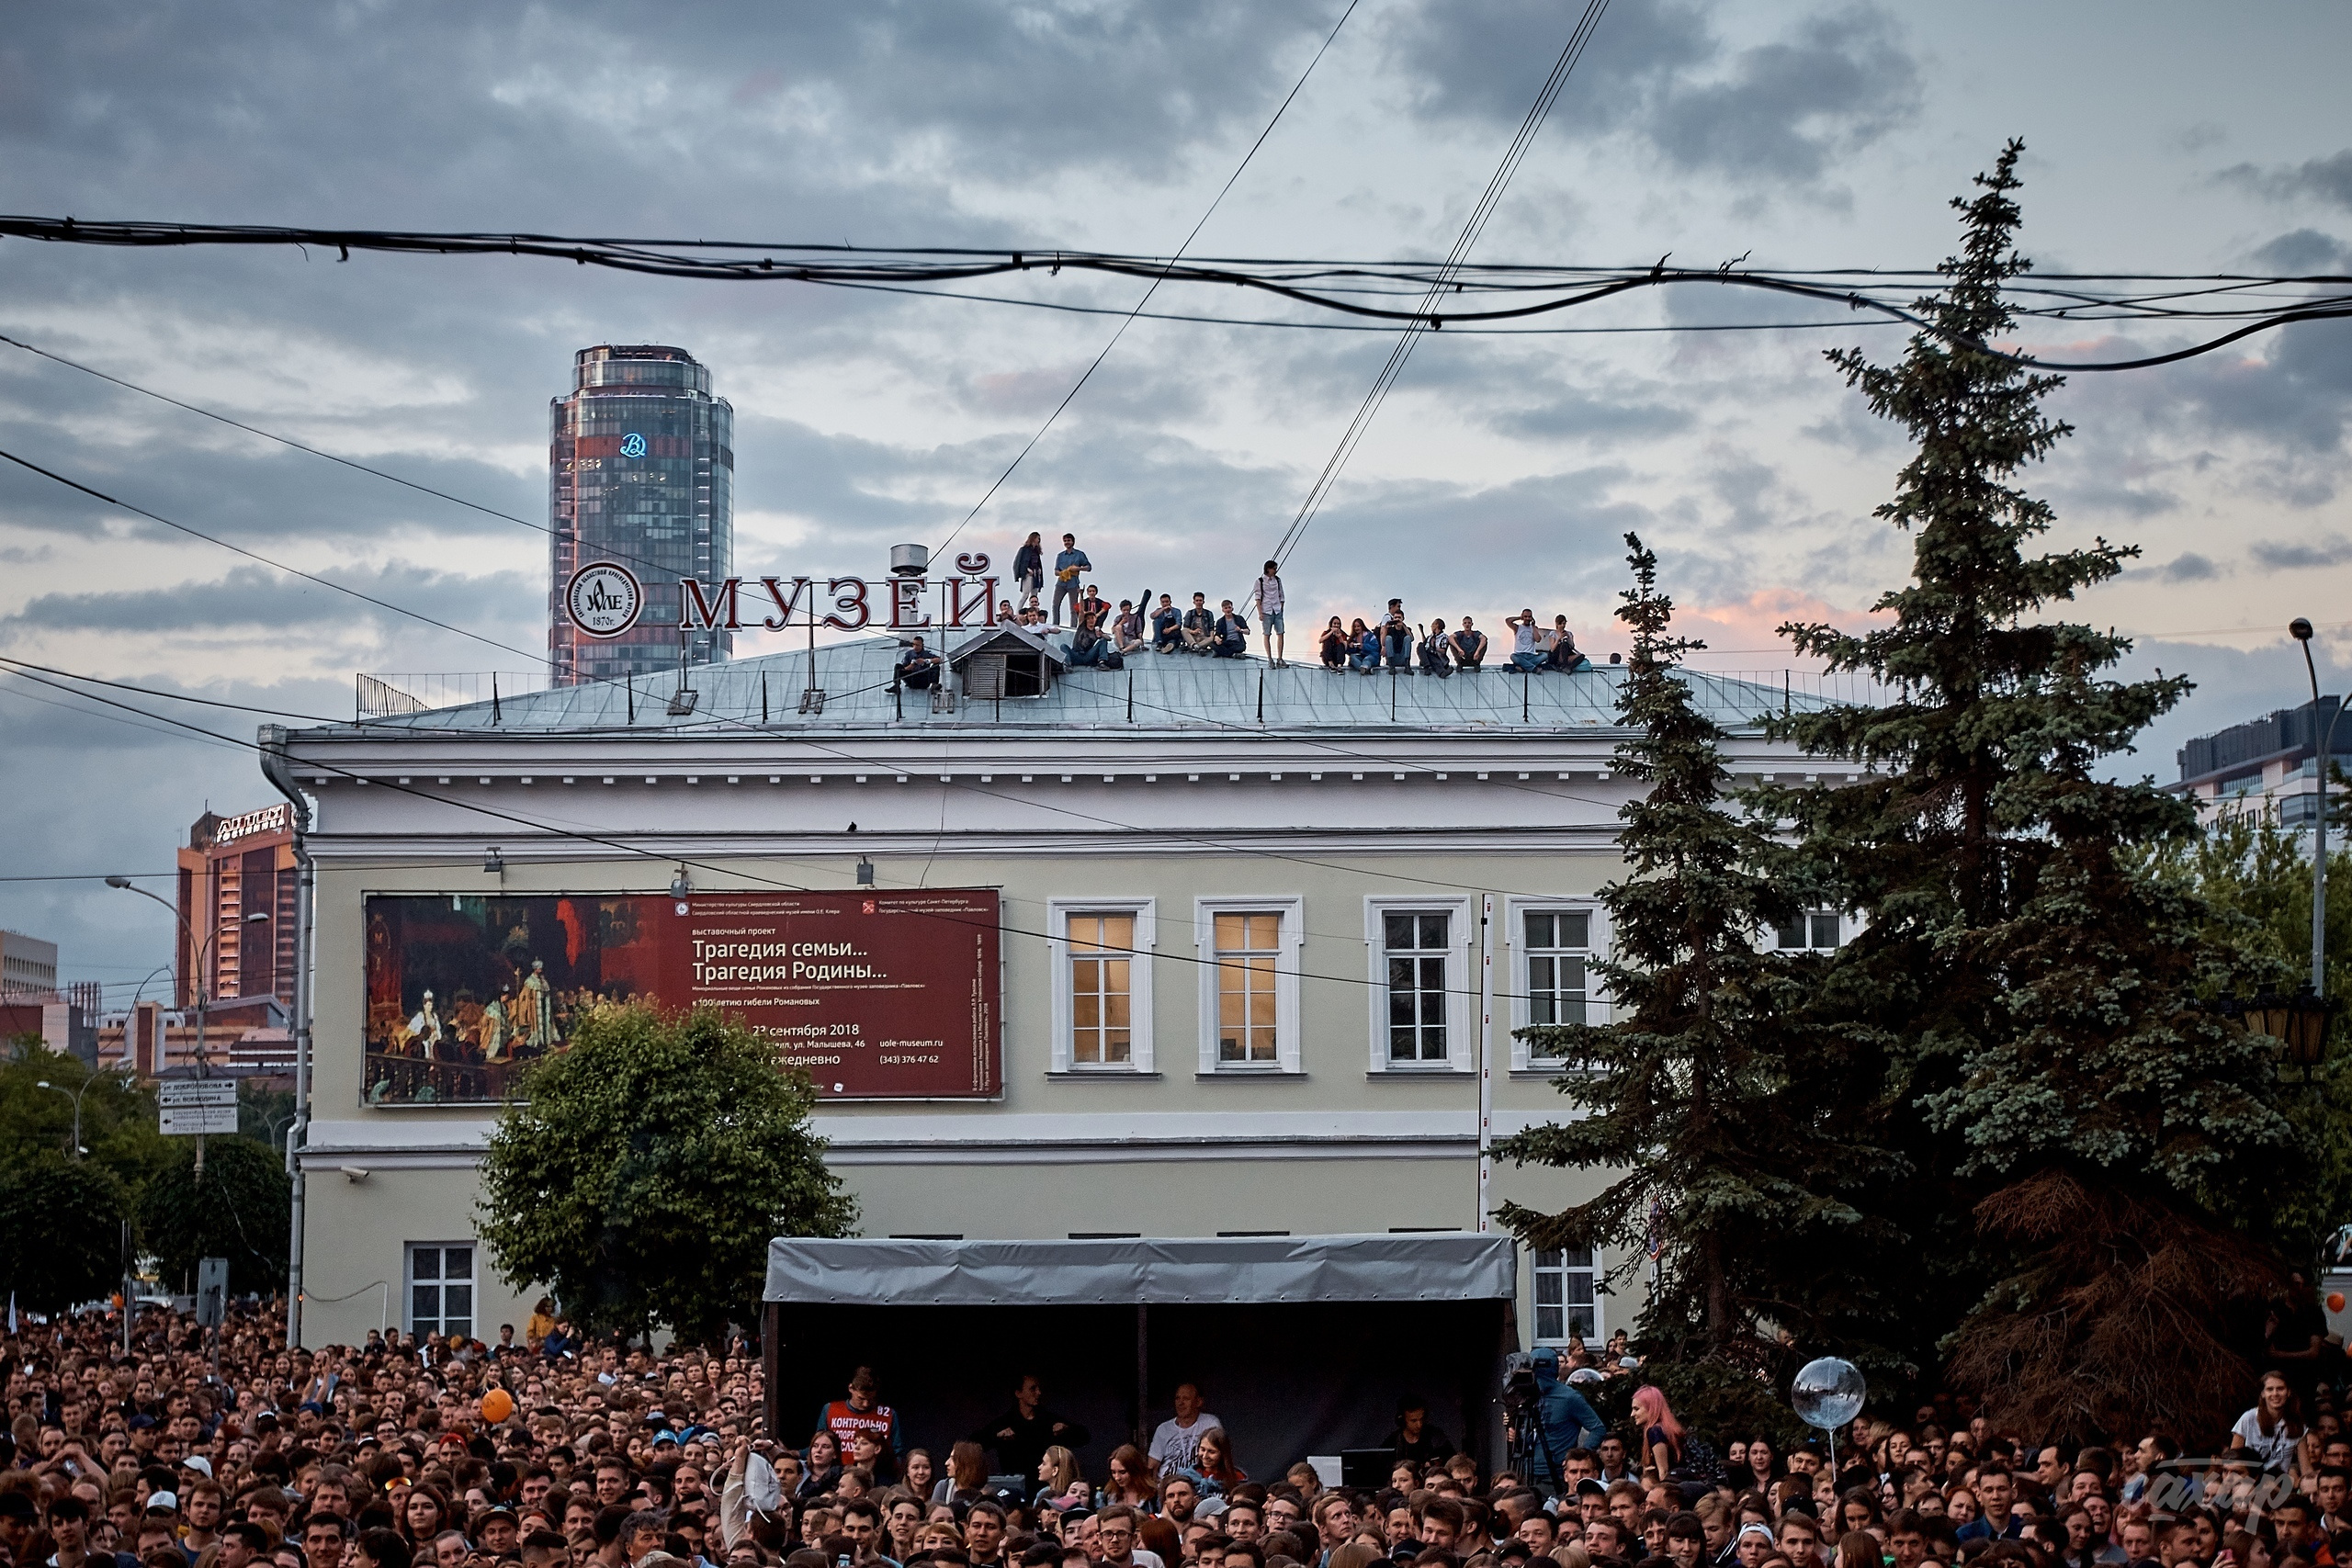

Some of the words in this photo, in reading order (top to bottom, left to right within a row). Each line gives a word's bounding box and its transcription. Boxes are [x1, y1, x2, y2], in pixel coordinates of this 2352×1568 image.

[679, 553, 1001, 632] МУЗЕЙ
[593, 616, 616, 626] 1870г.
[692, 927, 746, 935] выставочный
[748, 928, 776, 936] проект
[692, 940, 786, 963] Трагедия
[791, 942, 867, 956] семьи...
[692, 963, 786, 985] Трагедия
[792, 961, 887, 981] Родины...
[743, 998, 772, 1006] гибели
[774, 998, 820, 1006] Романовых
[769, 1024, 826, 1038] сентября
[830, 1024, 859, 1035] 2018
[793, 1042, 804, 1051] ул.
[807, 1040, 853, 1049] Малышева,
[854, 1040, 865, 1048] 46
[879, 1039, 943, 1048] uole-museum.ru
[879, 1055, 899, 1065] (343)
[901, 1055, 916, 1064] 376
[917, 1055, 928, 1064] 47
[929, 1055, 939, 1064] 62
[877, 1405, 890, 1416] 82
[831, 1417, 888, 1432] КОНТРОЛЬНО
